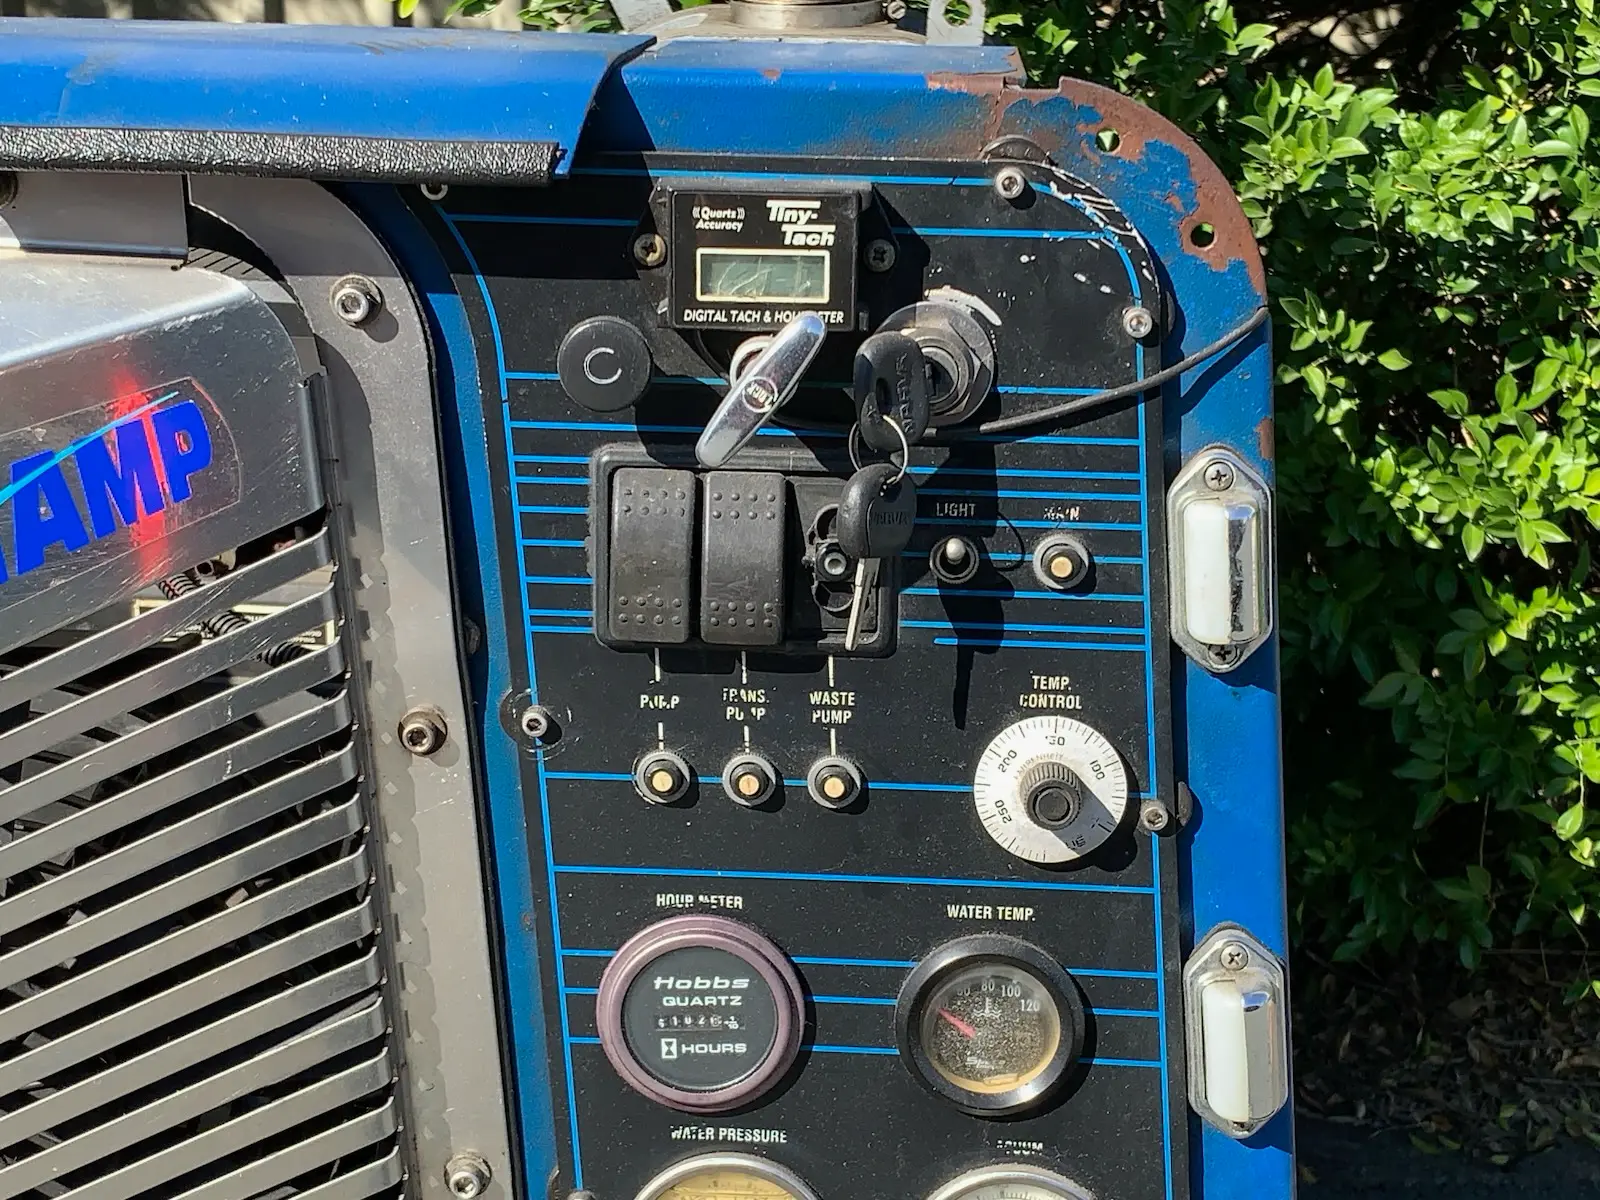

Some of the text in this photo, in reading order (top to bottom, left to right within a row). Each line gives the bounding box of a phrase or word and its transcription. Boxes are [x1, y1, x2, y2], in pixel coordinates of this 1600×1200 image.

[695, 219, 743, 232] Accuracy
[781, 224, 836, 246] Tach
[683, 308, 728, 322] DIGITAL
[730, 310, 761, 323] TACH
[763, 310, 772, 323] &
[0, 400, 213, 585] AMP
[936, 502, 976, 517] LIGHT
[1032, 675, 1072, 691] TEMP.
[809, 691, 855, 706] WASTE
[1020, 693, 1082, 710] CONTROL
[726, 706, 766, 721] PUP
[812, 709, 852, 724] PUMP
[1089, 759, 1106, 781] 100
[994, 799, 1013, 825] 250
[947, 904, 1036, 922] WATER TEMP.
[653, 976, 750, 990] Hobbs
[981, 979, 995, 992] 80
[1001, 984, 1021, 998] 100
[662, 995, 742, 1007] QUARTZ
[1020, 999, 1040, 1013] 120
[681, 1043, 747, 1054] HOURS
[670, 1126, 788, 1143] WATER PRESSURE
